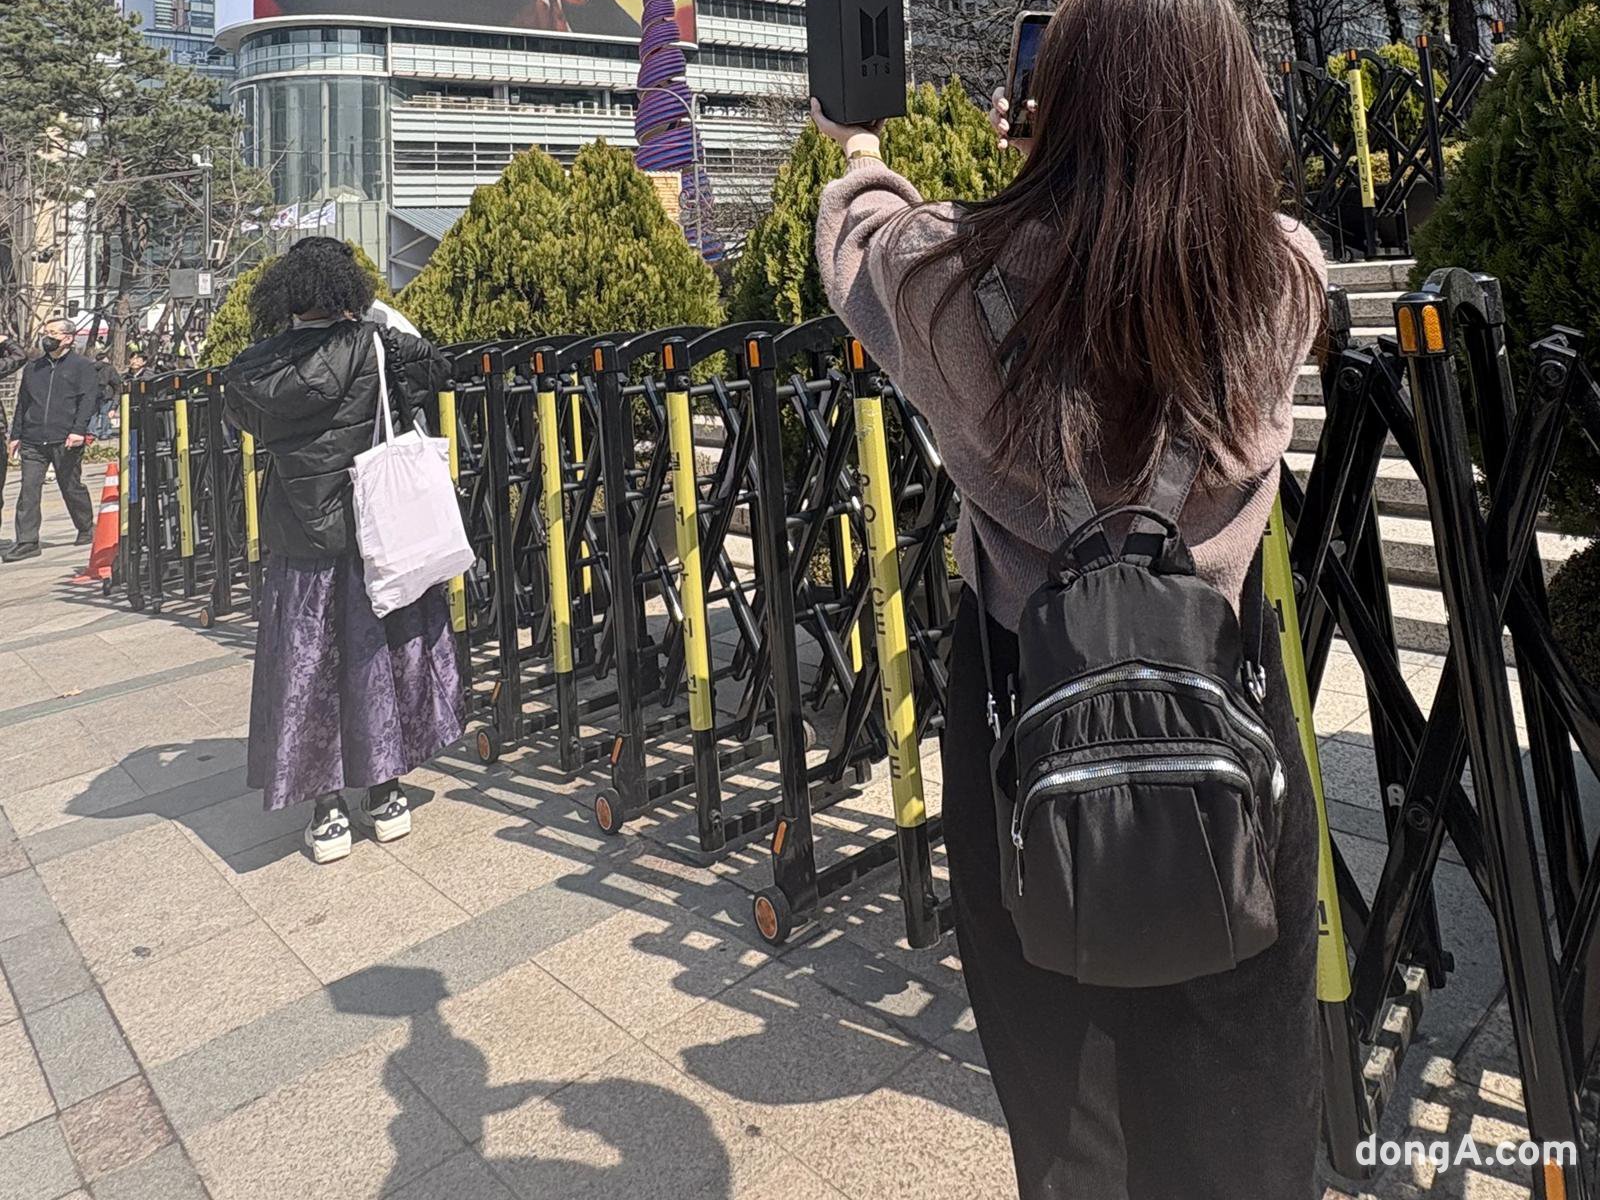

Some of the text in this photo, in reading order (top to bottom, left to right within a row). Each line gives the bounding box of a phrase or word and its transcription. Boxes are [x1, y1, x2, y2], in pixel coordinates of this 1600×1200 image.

[861, 63, 889, 76] BTS
[1352, 94, 1369, 192] POLICE LINE
[861, 474, 902, 779] POLICE LINE
